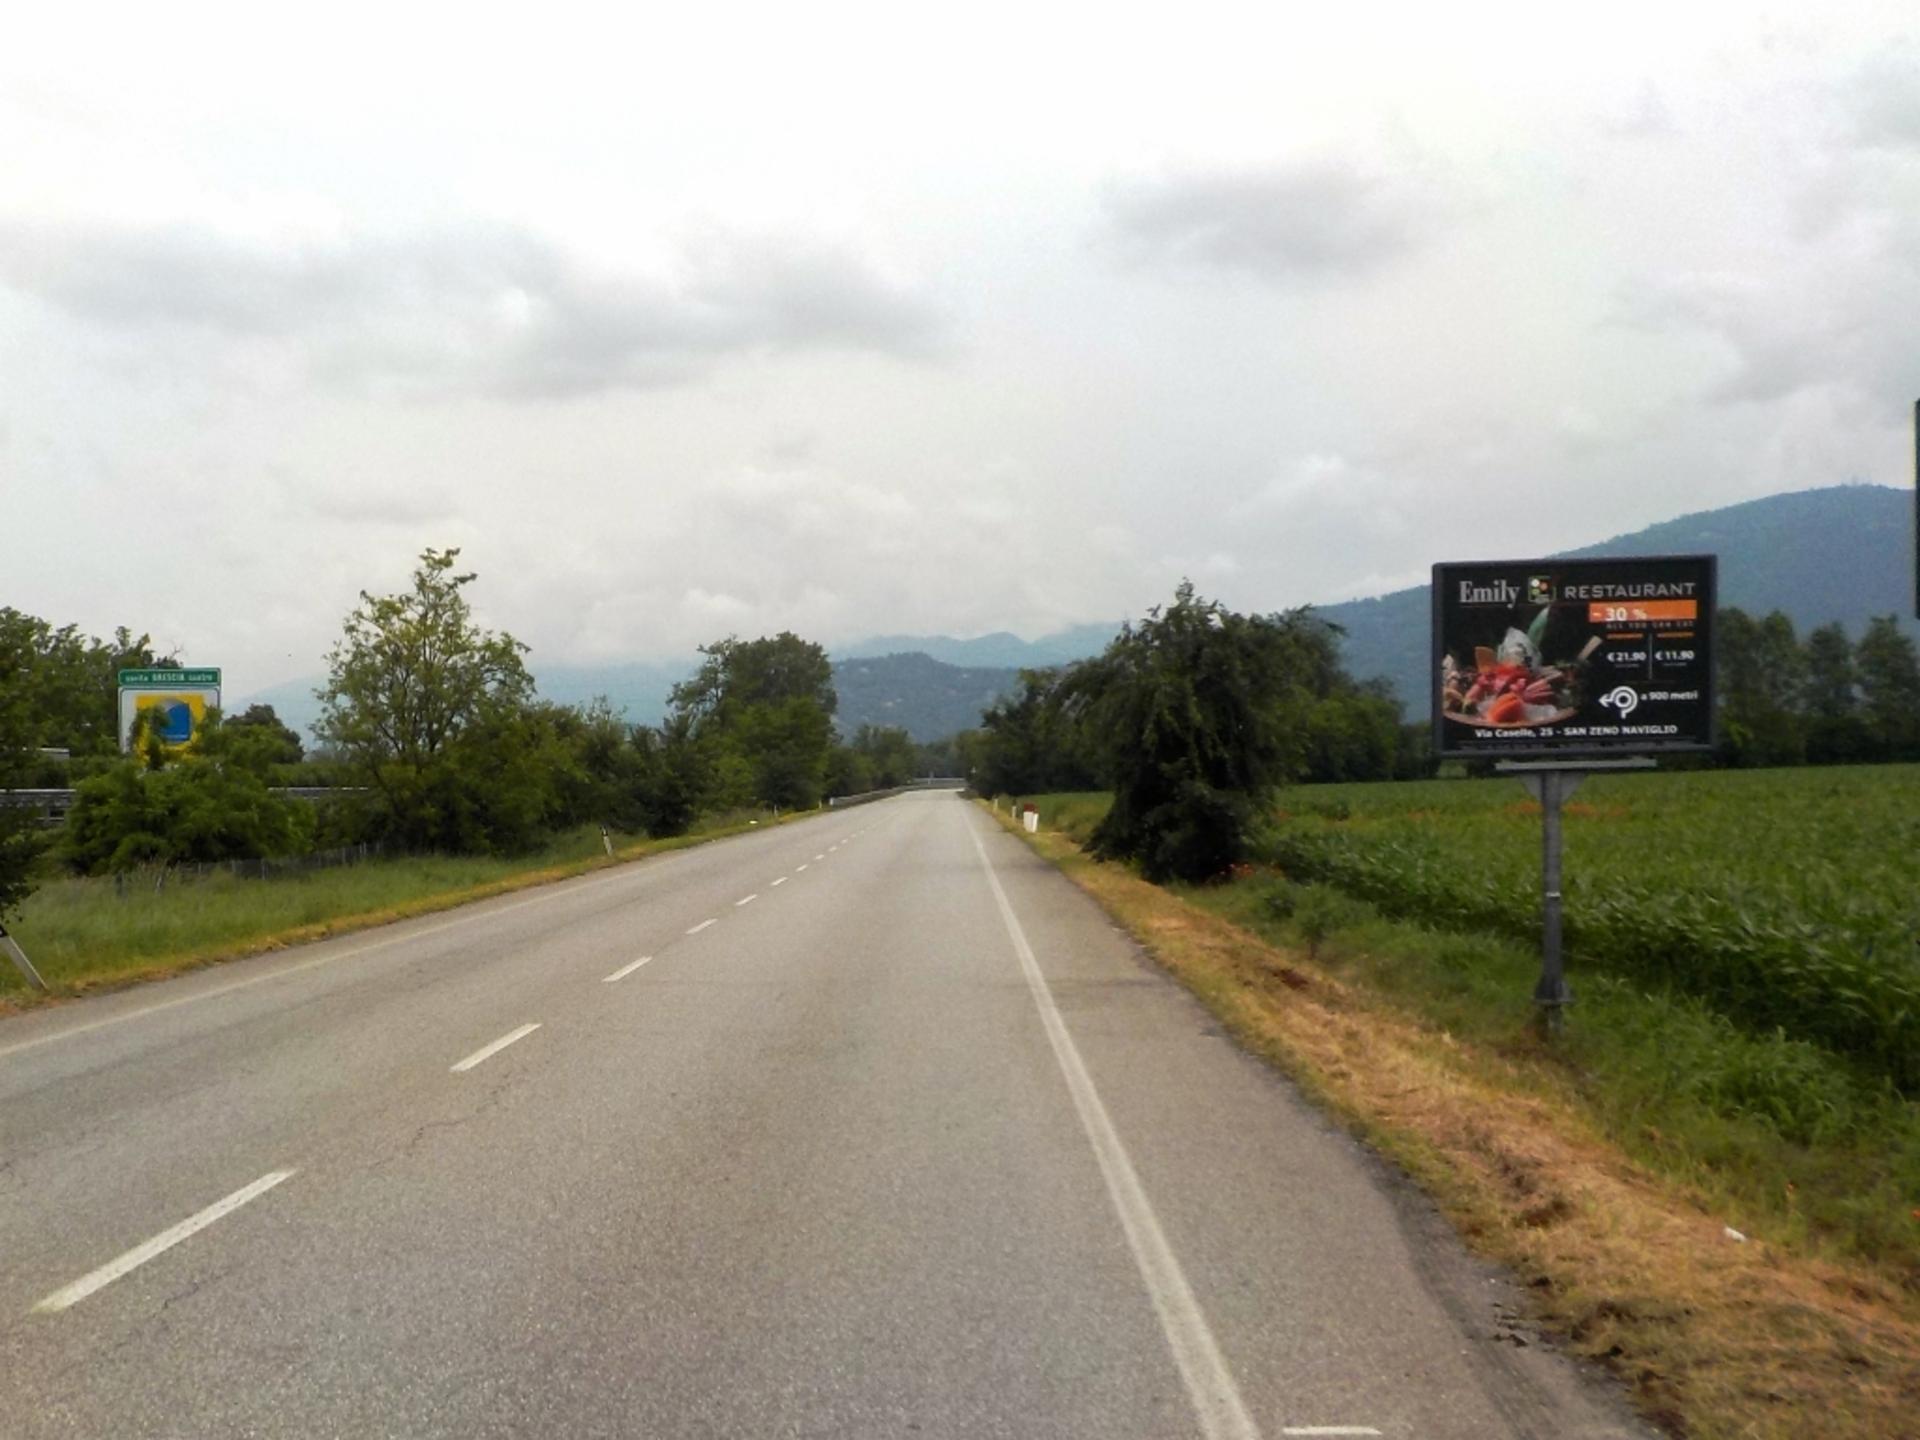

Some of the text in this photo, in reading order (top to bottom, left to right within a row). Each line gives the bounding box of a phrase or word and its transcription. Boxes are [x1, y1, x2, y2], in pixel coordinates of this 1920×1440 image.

[1459, 579, 1696, 608] Emily RESTAURANT
[1670, 690, 1698, 700] metri
[1474, 728, 1493, 738] Via
[1563, 726, 1587, 737] SAN
[1589, 725, 1620, 736] ZENO
[1621, 724, 1678, 735] NAVIGLIO
